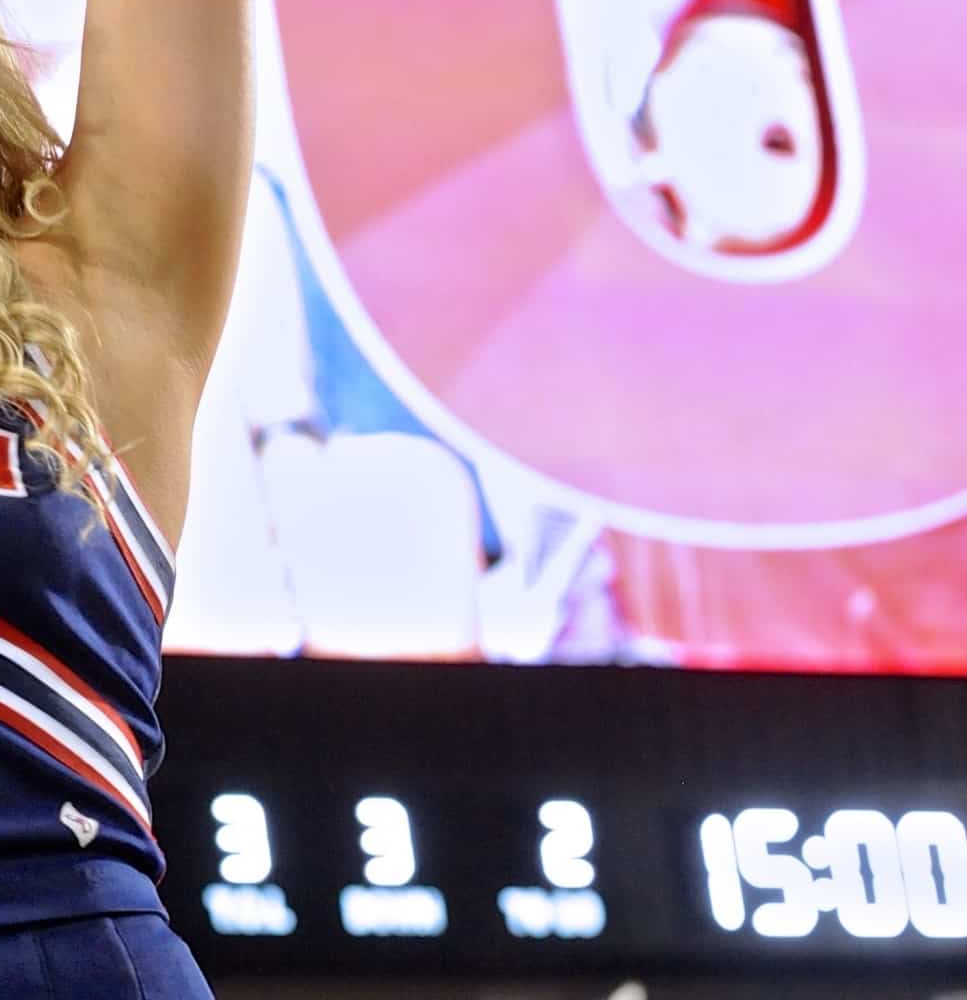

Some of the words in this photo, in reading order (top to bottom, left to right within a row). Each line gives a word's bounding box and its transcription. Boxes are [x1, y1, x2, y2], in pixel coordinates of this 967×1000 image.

[210, 793, 272, 884] 3
[355, 797, 416, 887] 3
[538, 800, 595, 889] 2
[699, 807, 967, 939] 15:00
